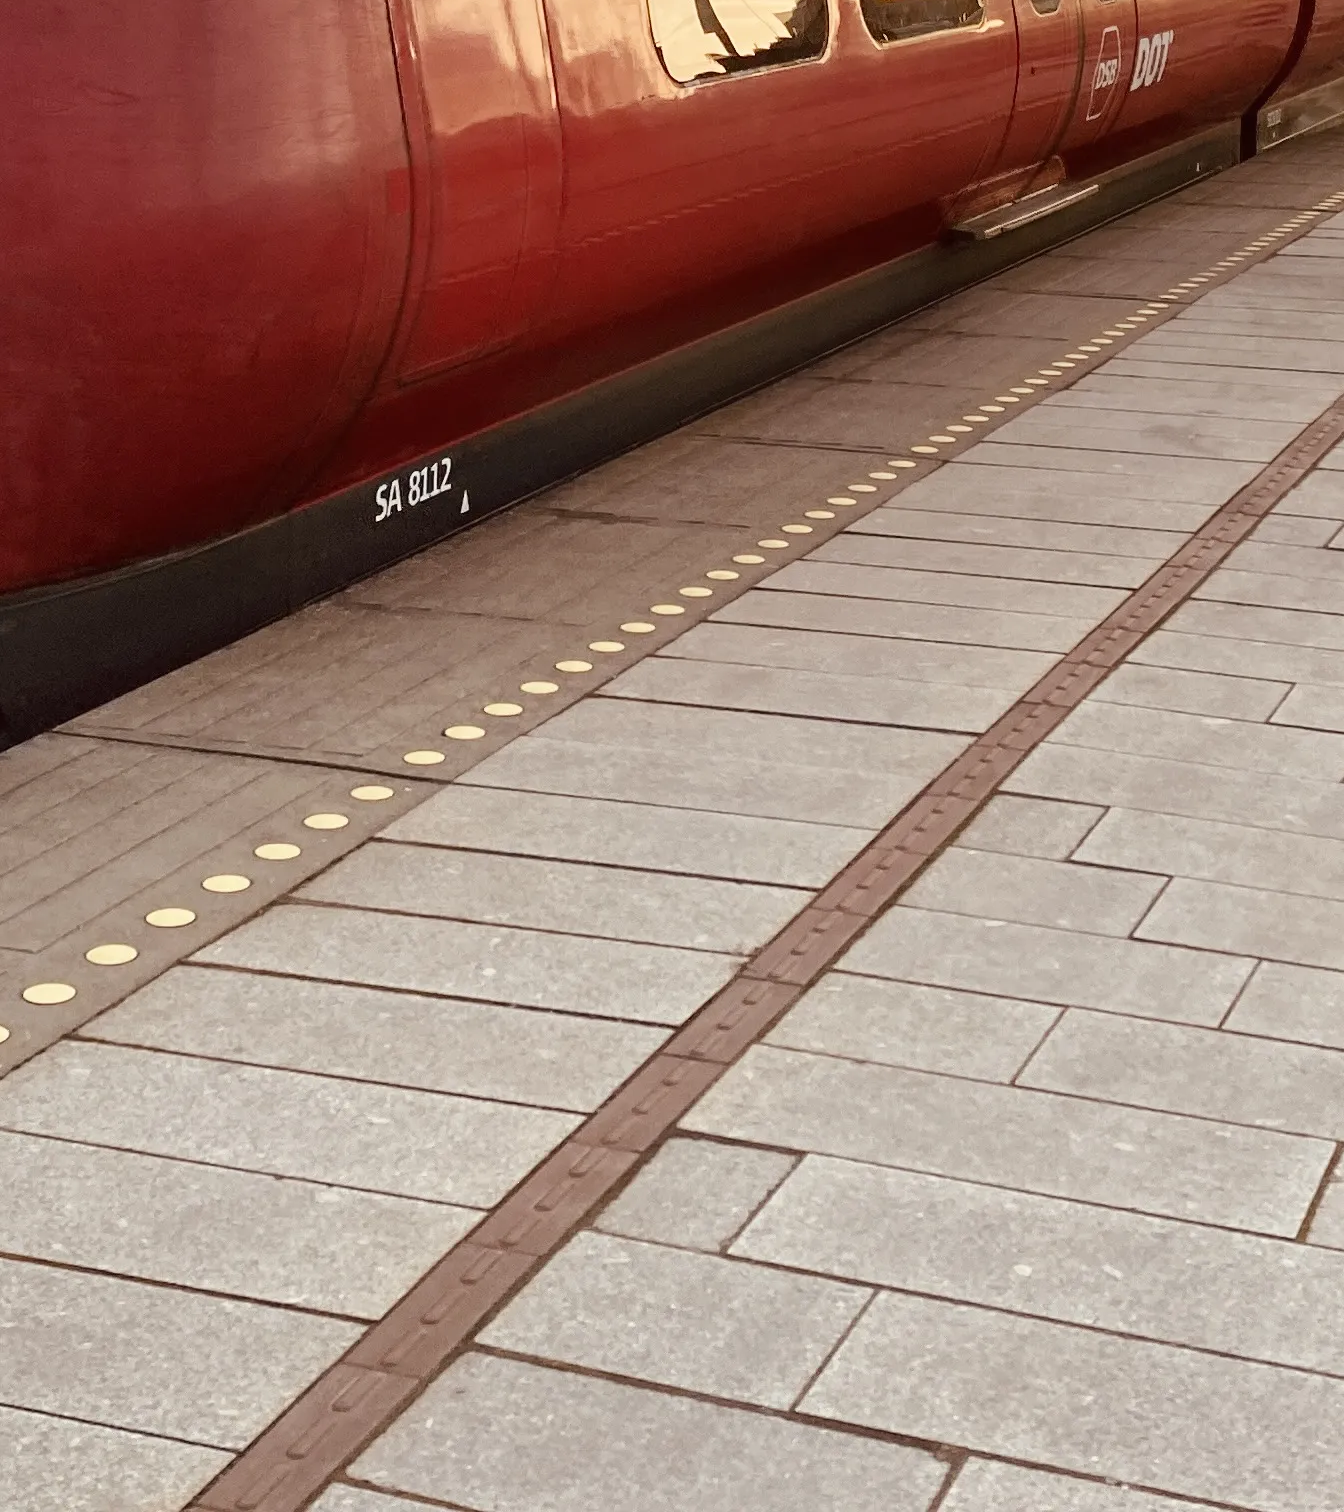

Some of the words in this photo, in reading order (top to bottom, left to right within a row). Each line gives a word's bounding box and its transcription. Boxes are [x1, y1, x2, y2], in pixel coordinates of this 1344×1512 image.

[1095, 58, 1118, 90] DSB
[375, 478, 402, 523] SA
[408, 457, 452, 507] 8112
